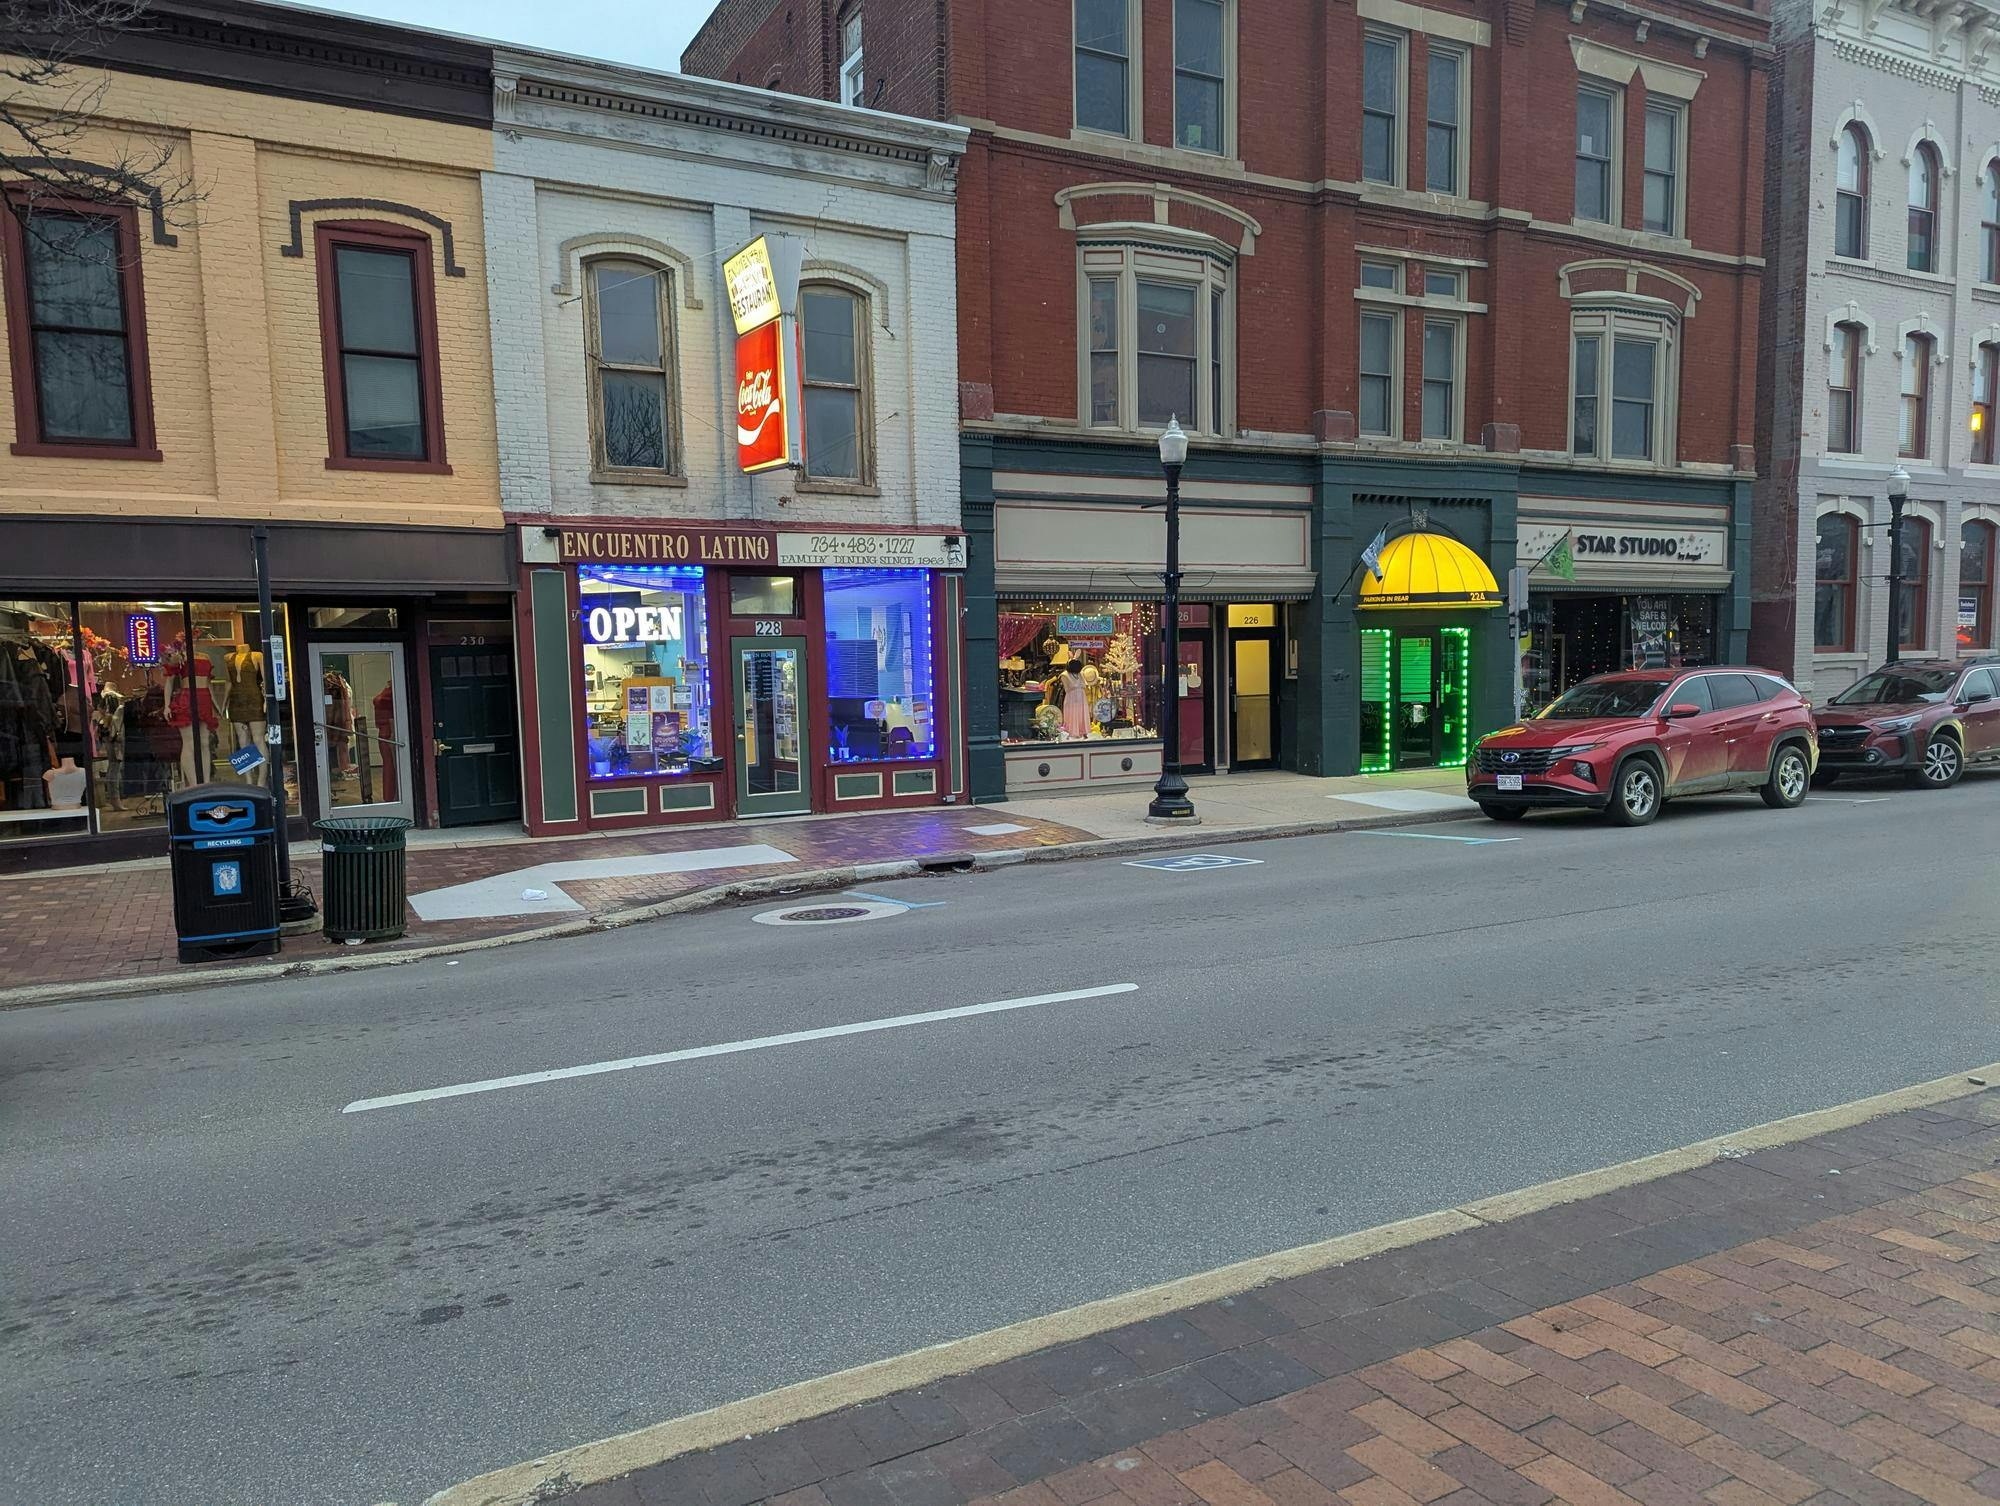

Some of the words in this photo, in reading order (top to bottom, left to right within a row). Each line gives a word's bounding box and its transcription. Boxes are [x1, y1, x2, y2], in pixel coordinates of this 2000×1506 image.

[732, 280, 775, 320] RESTAURANT
[562, 531, 689, 559] ENCUENTRO
[700, 535, 769, 560] LATINO
[1577, 535, 1616, 553] STAR
[1620, 536, 1678, 556] STUDIO
[780, 555, 829, 564] FAMILY
[834, 555, 877, 564] DINING
[880, 556, 915, 565] SINCE
[918, 557, 945, 565] 1963
[1470, 592, 1486, 601] 224
[1636, 599, 1652, 610] YOU
[1243, 616, 1259, 625] 226
[1640, 611, 1658, 620] SAFE
[1660, 611, 1666, 620] &
[589, 606, 682, 642] OPEN
[756, 621, 781, 635] 228
[1060, 616, 1111, 632] JEANNE'S
[135, 620, 150, 657] OPEN
[460, 636, 485, 646] 230
[230, 752, 250, 764] Open
[207, 839, 242, 847] RECYCLING
